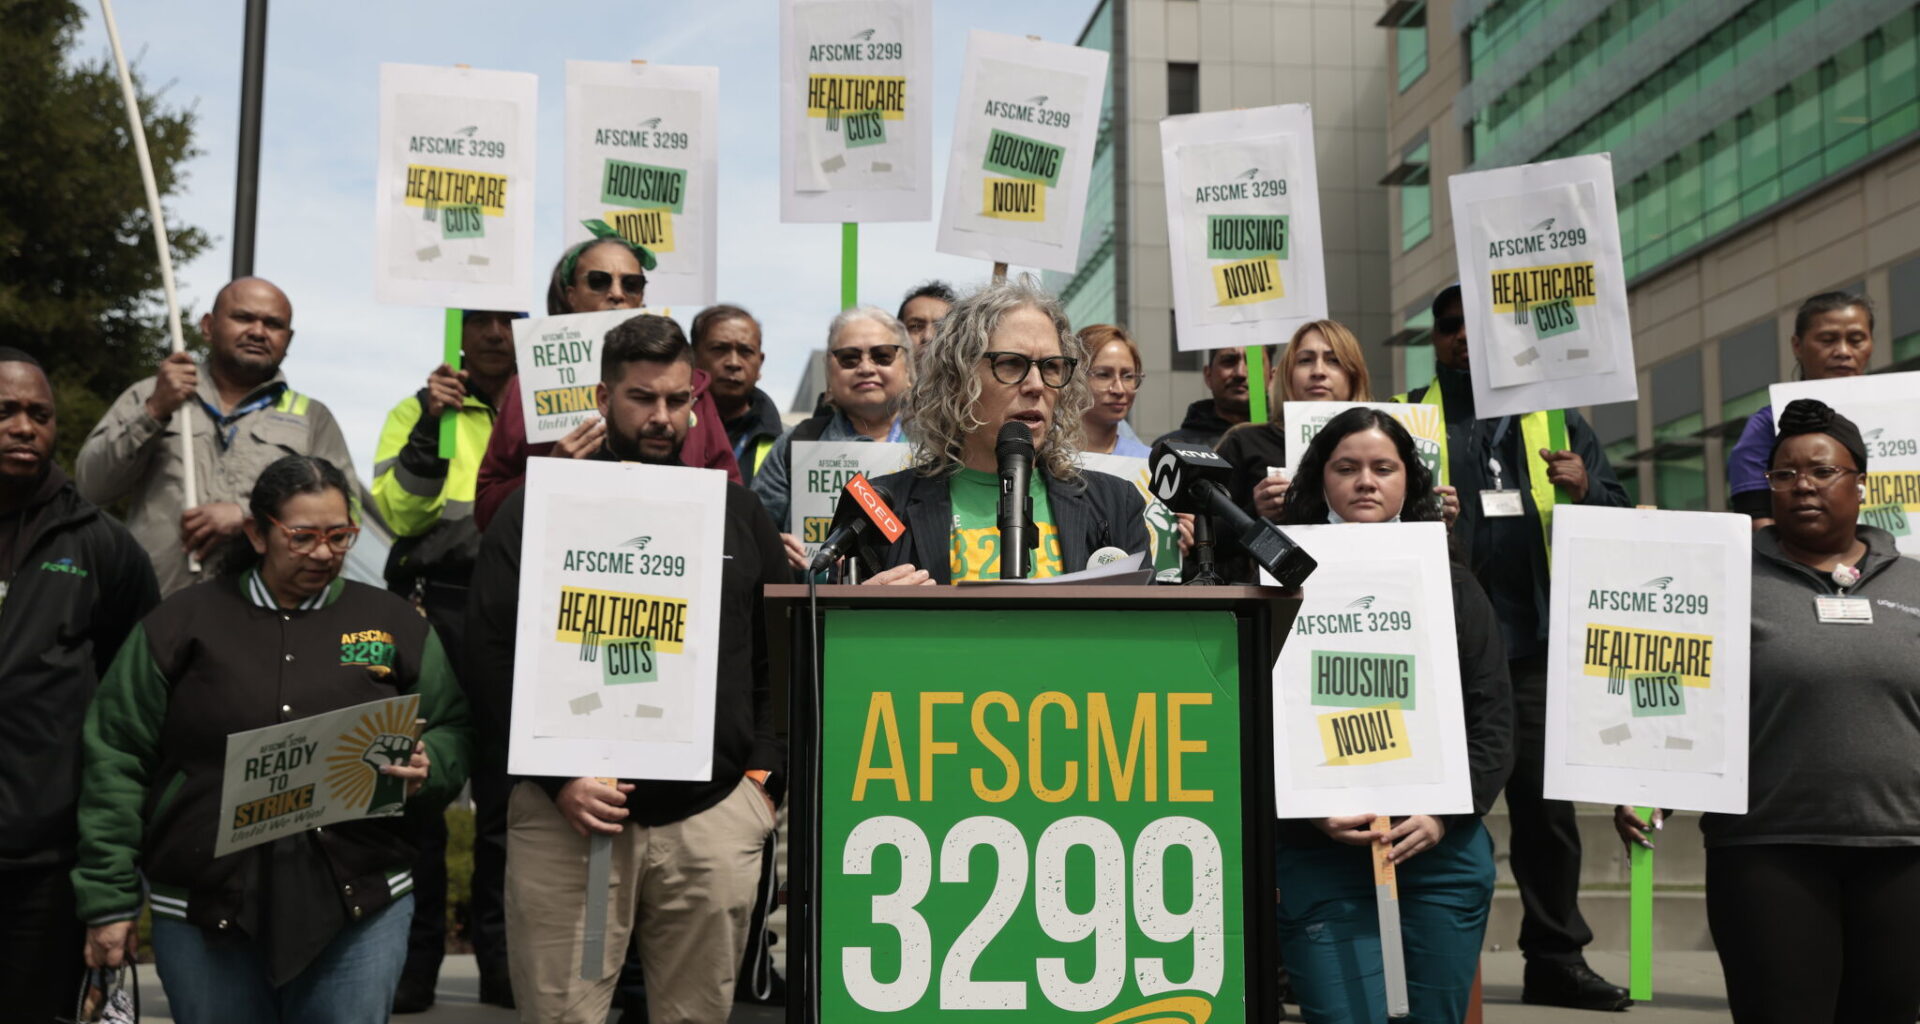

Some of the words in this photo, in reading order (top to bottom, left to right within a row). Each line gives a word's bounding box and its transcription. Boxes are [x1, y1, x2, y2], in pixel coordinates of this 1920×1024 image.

[809, 43, 863, 61] AFSCME
[867, 42, 902, 60] 3299
[808, 77, 906, 112] HEALTHCARE
[846, 111, 882, 141] CUTS
[984, 99, 1035, 123] AFSCME
[1037, 108, 1071, 128] 3299
[409, 135, 466, 156] AFSCME
[468, 139, 505, 158] 3299
[595, 128, 649, 148] AFSCME
[653, 132, 688, 150] 3299
[989, 133, 1060, 179] HOUSING
[406, 167, 508, 209] HEALTHCARE
[607, 163, 681, 205] HOUSING
[992, 182, 1036, 213] NOW!
[1196, 183, 1248, 203] AFSCME
[1252, 179, 1287, 198] 3299
[445, 206, 481, 233] CUTS
[615, 212, 664, 245] NOW!
[1212, 218, 1284, 251] HOUSING
[1489, 234, 1545, 259] AFSCME
[1548, 227, 1587, 249] 3299
[1223, 260, 1273, 299] NOW!
[1492, 265, 1596, 305] HEALTHCARE
[1535, 300, 1574, 332] CUTS
[533, 340, 592, 367] READY
[557, 367, 576, 384] TO
[538, 416, 568, 431] Until
[1877, 439, 1917, 457] 3299
[853, 480, 898, 533] KQED
[563, 549, 635, 574] AFSCME
[639, 554, 685, 577] 3299
[950, 533, 1062, 579] 329
[557, 591, 687, 643] HEALTHCARE
[1588, 589, 1657, 612] AFSCME
[1663, 593, 1708, 615] 3299
[1296, 612, 1363, 635] AFSCME
[1367, 610, 1411, 632] 3299
[579, 631, 599, 662] NO
[607, 640, 652, 676] CUTS
[1585, 628, 1712, 677] HEALTHCARE
[1318, 655, 1409, 698] HOUSING
[1607, 665, 1625, 695] NO
[1634, 675, 1680, 708] CUTS
[851, 691, 1214, 802] AFSCME
[1331, 709, 1396, 757] NOW!
[244, 741, 318, 782] READY
[268, 773, 288, 793] TO
[234, 784, 315, 829] STRIKE
[842, 816, 1224, 1012] 3299
